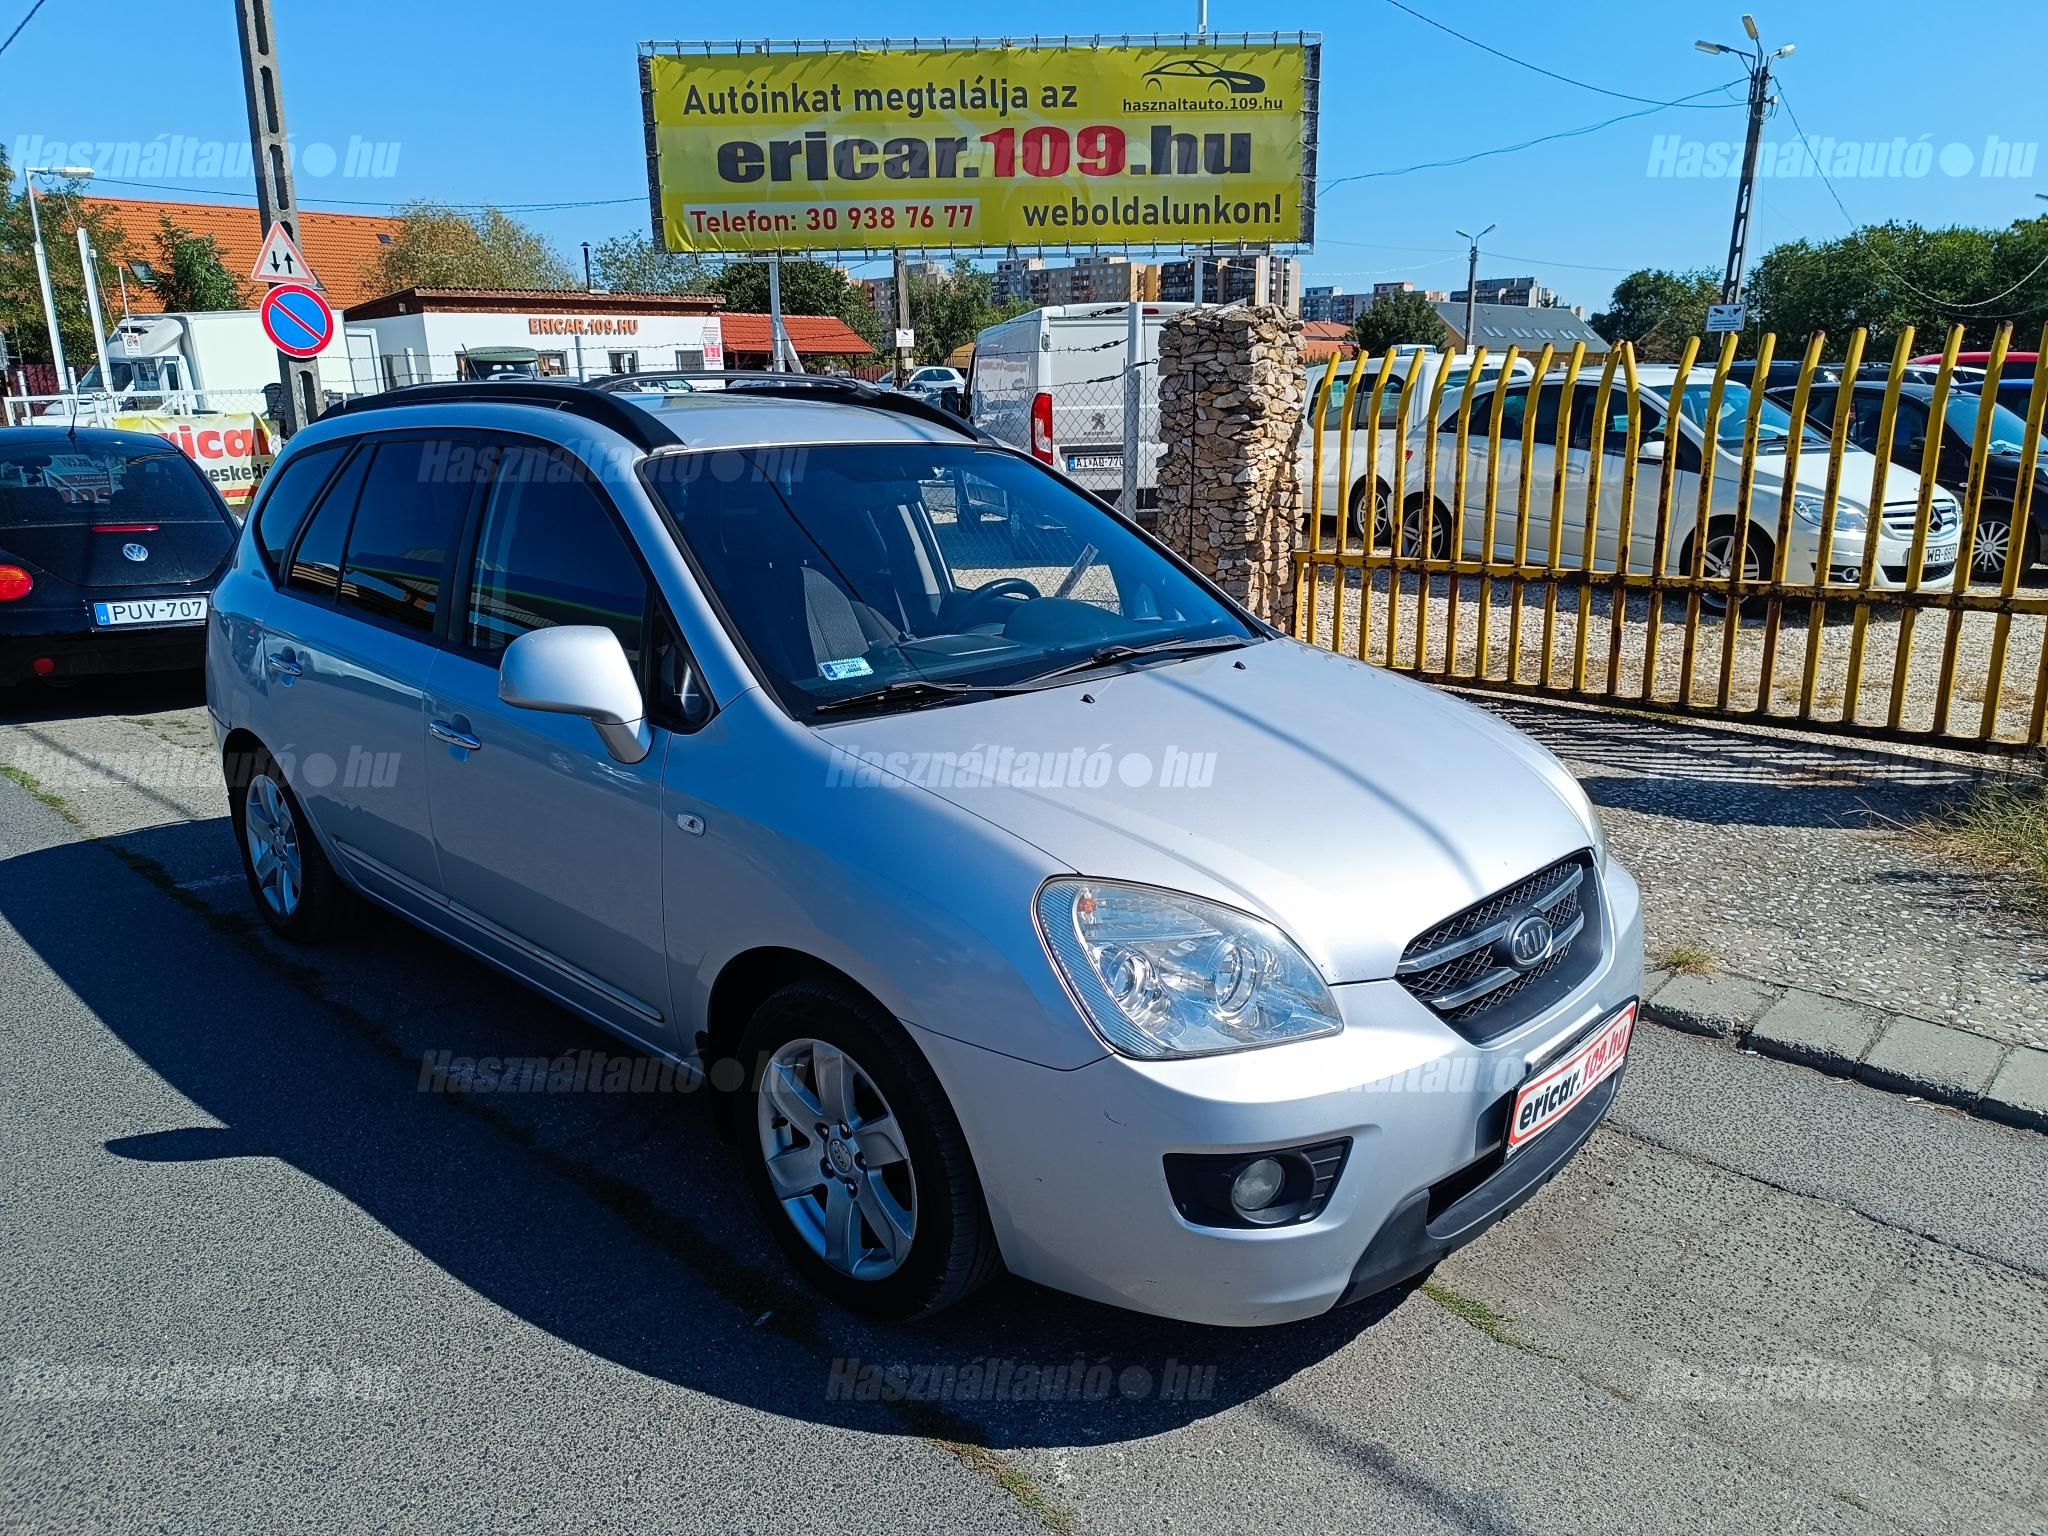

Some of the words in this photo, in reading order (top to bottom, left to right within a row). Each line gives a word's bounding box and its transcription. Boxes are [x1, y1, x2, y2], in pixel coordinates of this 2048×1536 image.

[683, 80, 841, 115] Autóinkat
[854, 75, 1028, 118] megtalálja
[1041, 84, 1077, 108] az
[1123, 97, 1283, 112] hasznaltauto.109.hu
[717, 125, 1251, 183] ericar.109.hu
[690, 210, 797, 233] Telefon:
[806, 208, 838, 230] 30
[848, 206, 895, 229] 938
[905, 206, 934, 228] 76
[944, 205, 973, 227] 77
[1023, 194, 1281, 226] weboldalunkon!
[529, 318, 638, 335] ERICAR.109.HU
[113, 602, 202, 620] PUV-707
[1517, 924, 1550, 958] KIA
